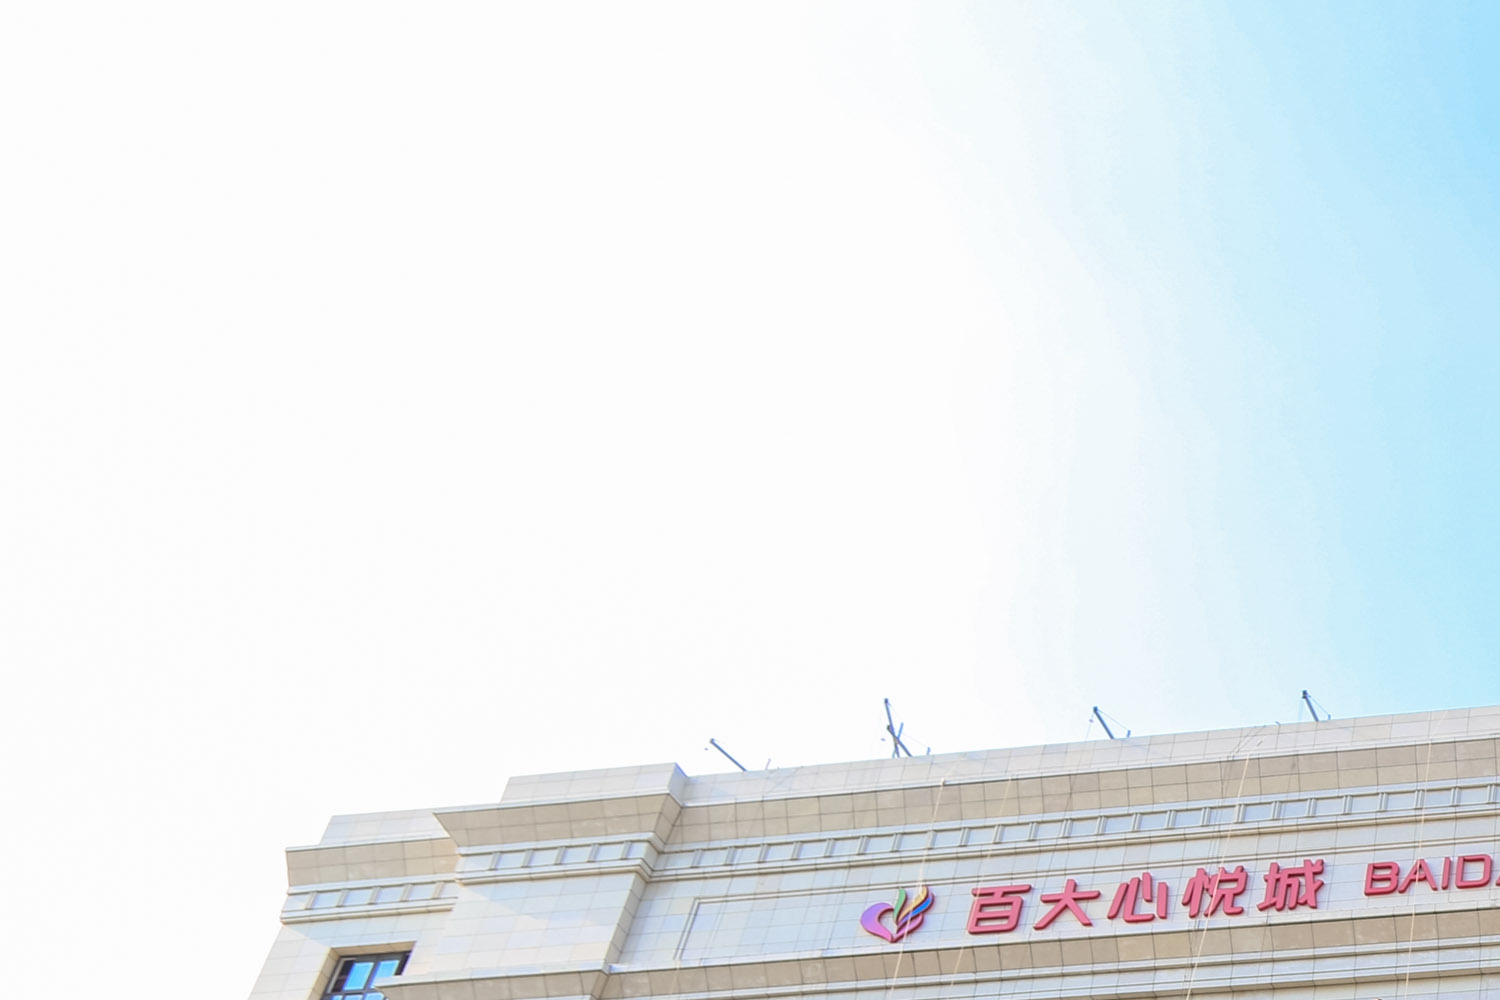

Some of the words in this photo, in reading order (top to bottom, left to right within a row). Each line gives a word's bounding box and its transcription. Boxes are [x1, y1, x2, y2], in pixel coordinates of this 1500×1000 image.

[966, 858, 1325, 935] 百大心悦城
